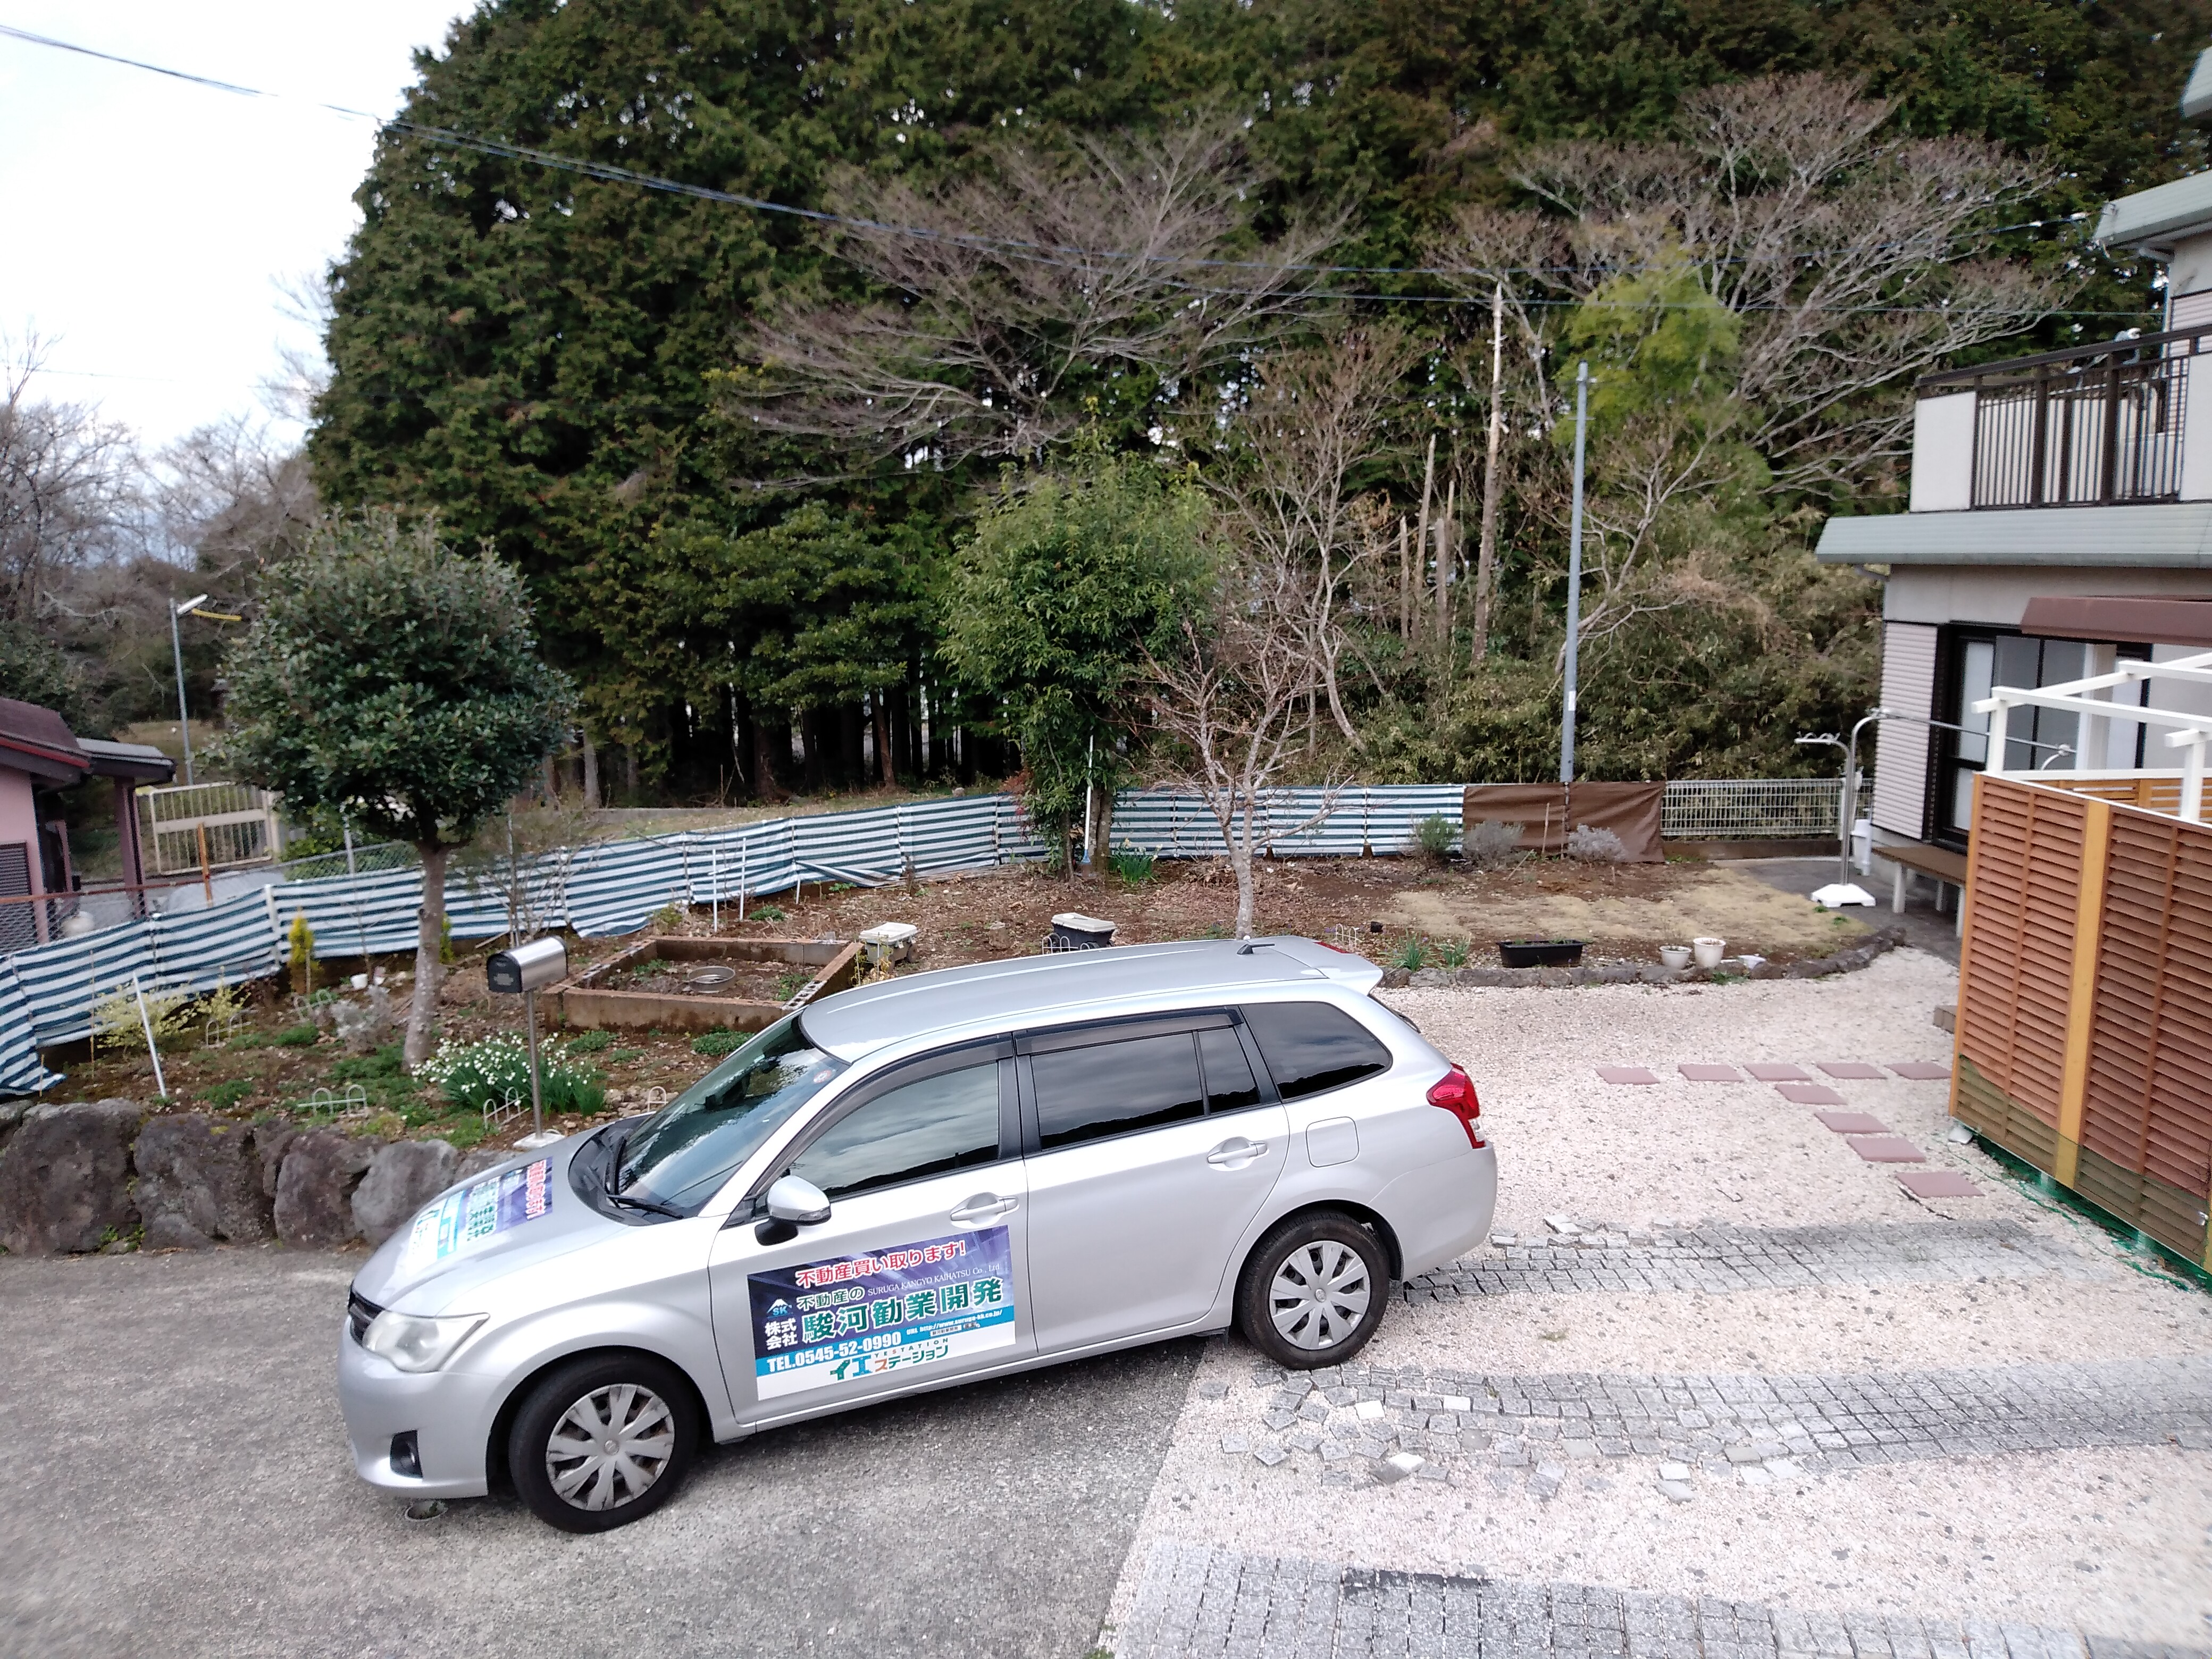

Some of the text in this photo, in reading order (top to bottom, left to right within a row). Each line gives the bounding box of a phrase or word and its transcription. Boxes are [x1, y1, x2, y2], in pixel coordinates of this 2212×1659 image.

[868, 1285, 900, 1296] SURUGA
[901, 1277, 933, 1289] KANGYO
[934, 1269, 970, 1283] KAIHATSU
[988, 1263, 1000, 1272] Ltd
[773, 1306, 787, 1315] SK
[797, 1286, 865, 1312] 不動産の
[802, 1276, 1003, 1343] 駿河勧業開発
[920, 1310, 1002, 1333] http://www.suruga-kk.co.jp/
[767, 1331, 901, 1371] TEL.0545-52-0990
[875, 1338, 948, 1357] YESTATION
